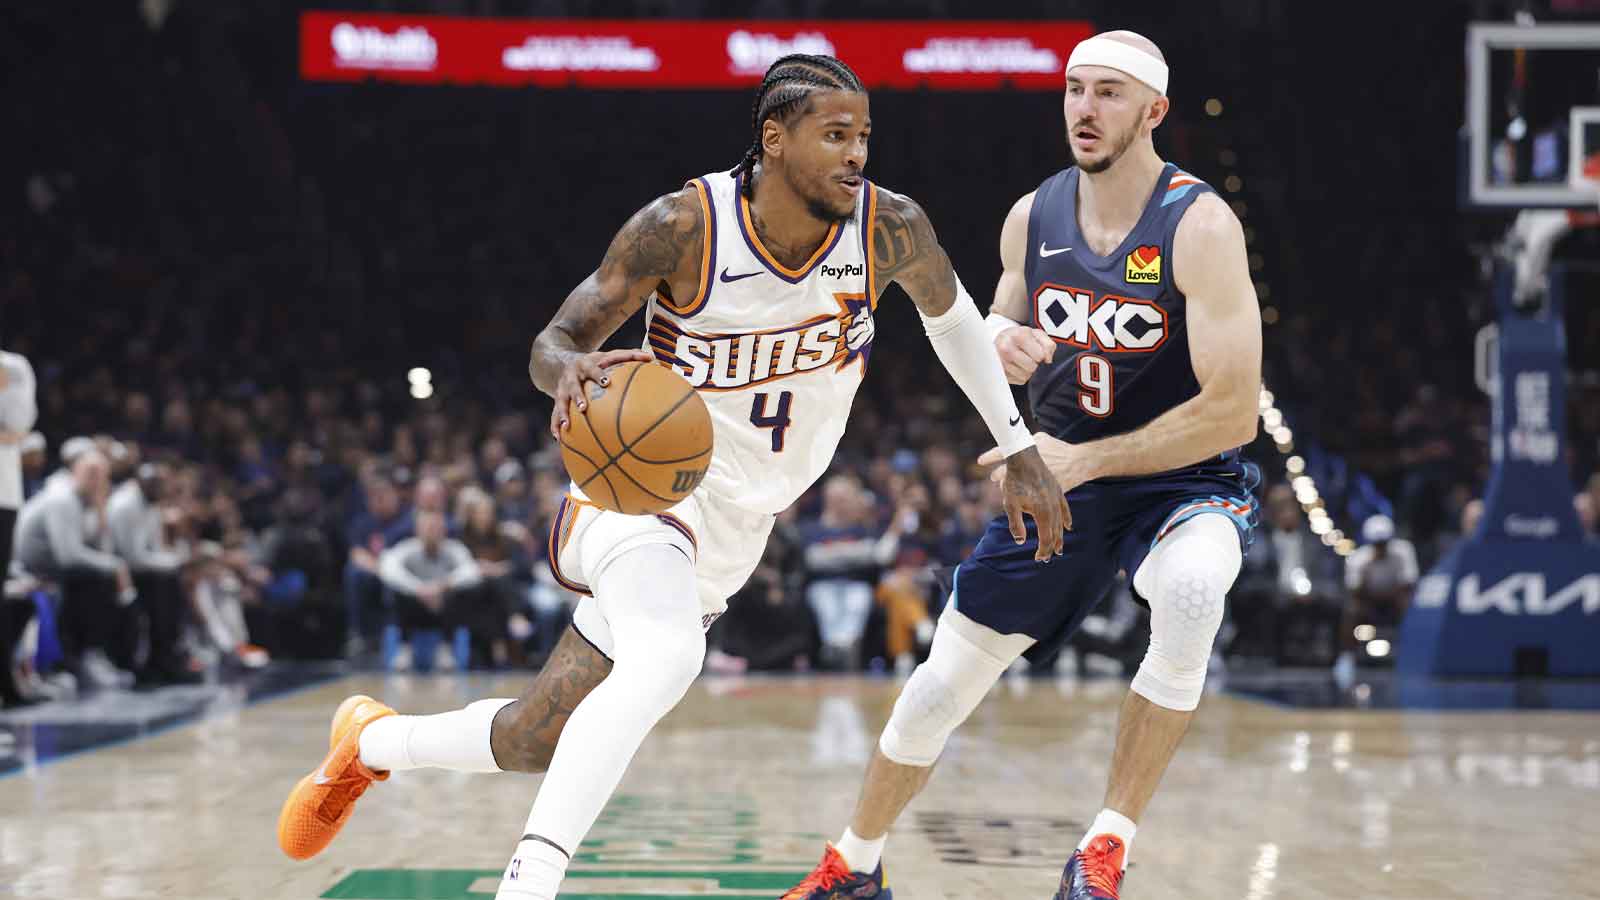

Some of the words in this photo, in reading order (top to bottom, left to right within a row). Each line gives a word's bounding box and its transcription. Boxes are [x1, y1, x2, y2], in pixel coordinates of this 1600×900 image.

[820, 264, 863, 279] PayPal
[1035, 284, 1166, 351] OKC
[1077, 353, 1114, 418] 9
[750, 391, 793, 452] 4
